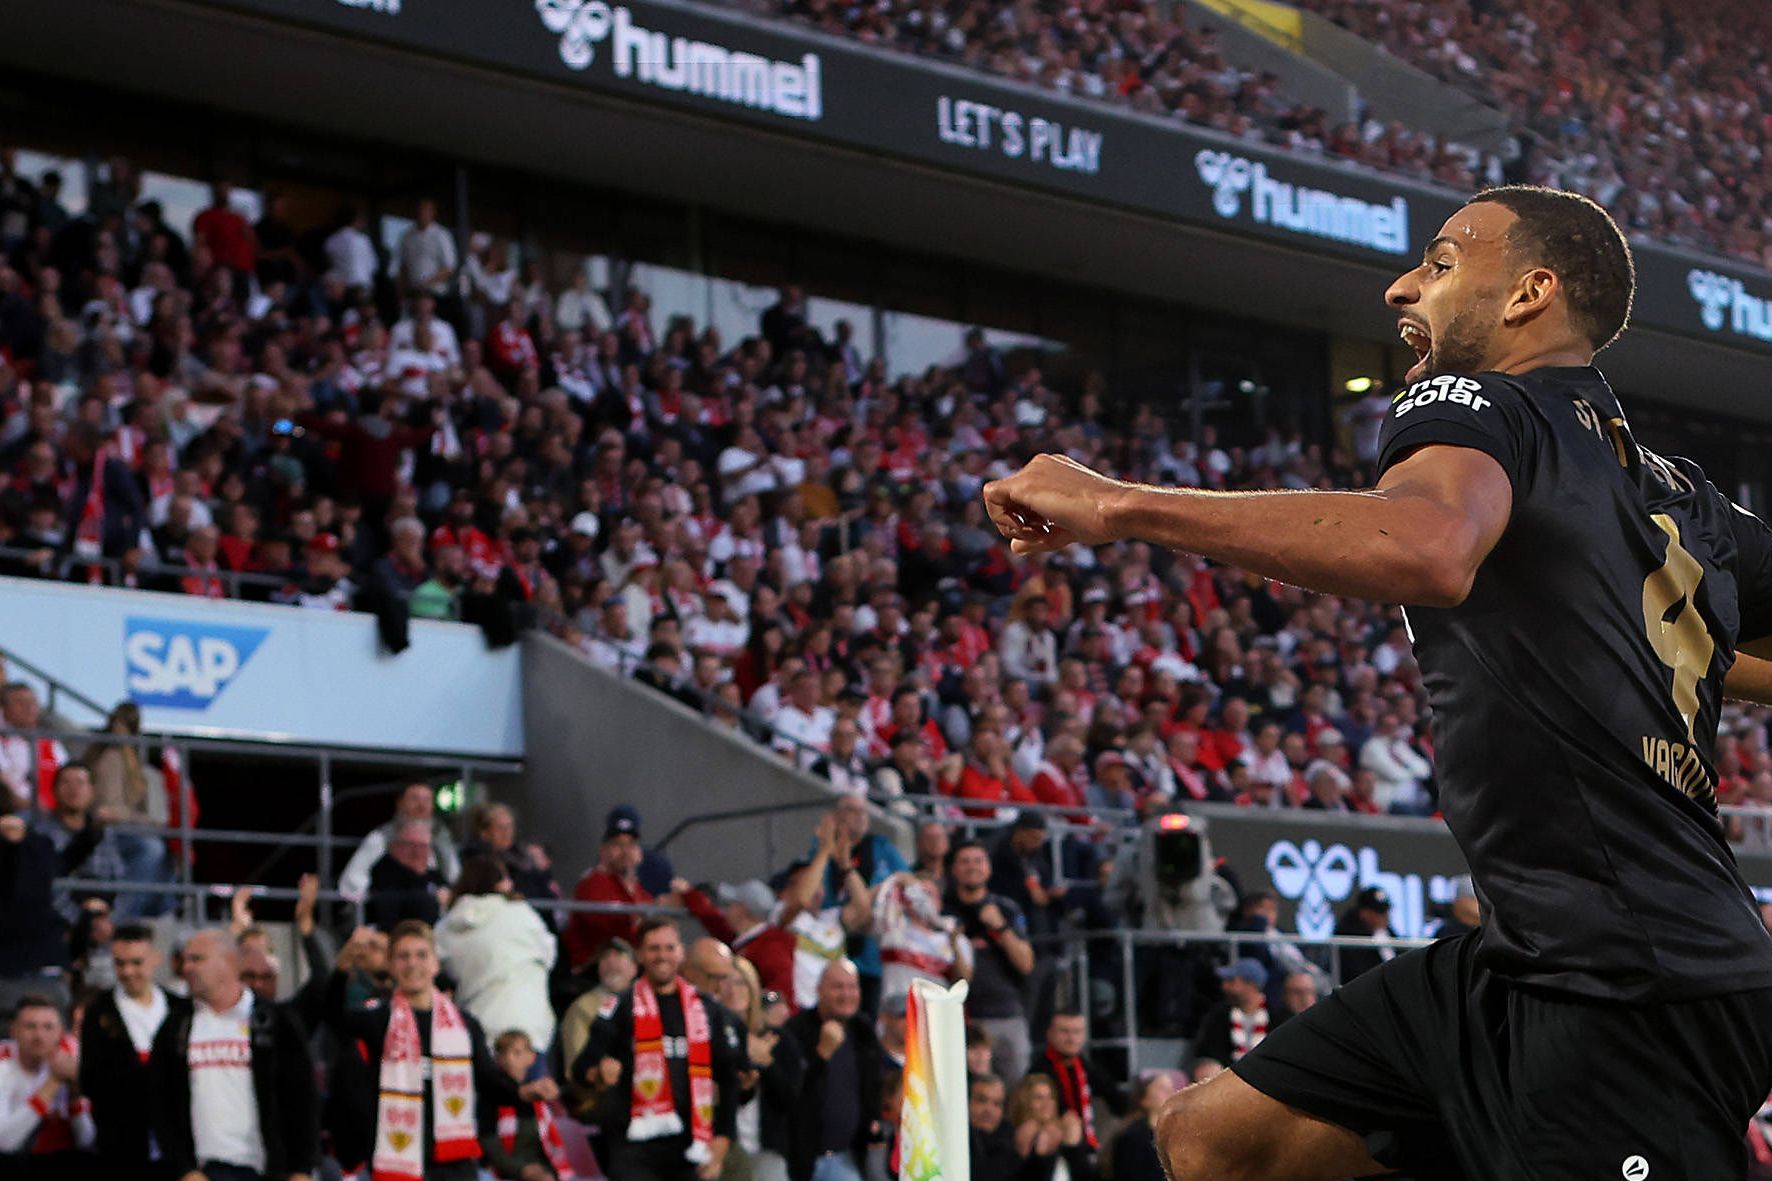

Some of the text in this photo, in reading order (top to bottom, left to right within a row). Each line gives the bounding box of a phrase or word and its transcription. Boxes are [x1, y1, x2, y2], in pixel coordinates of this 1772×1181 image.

[612, 6, 823, 121] hummel
[937, 95, 1103, 175] LET'S PLAY
[1251, 161, 1410, 255] hummel
[1394, 383, 1492, 418] solar
[1407, 374, 1483, 398] nep
[127, 630, 240, 696] SAP
